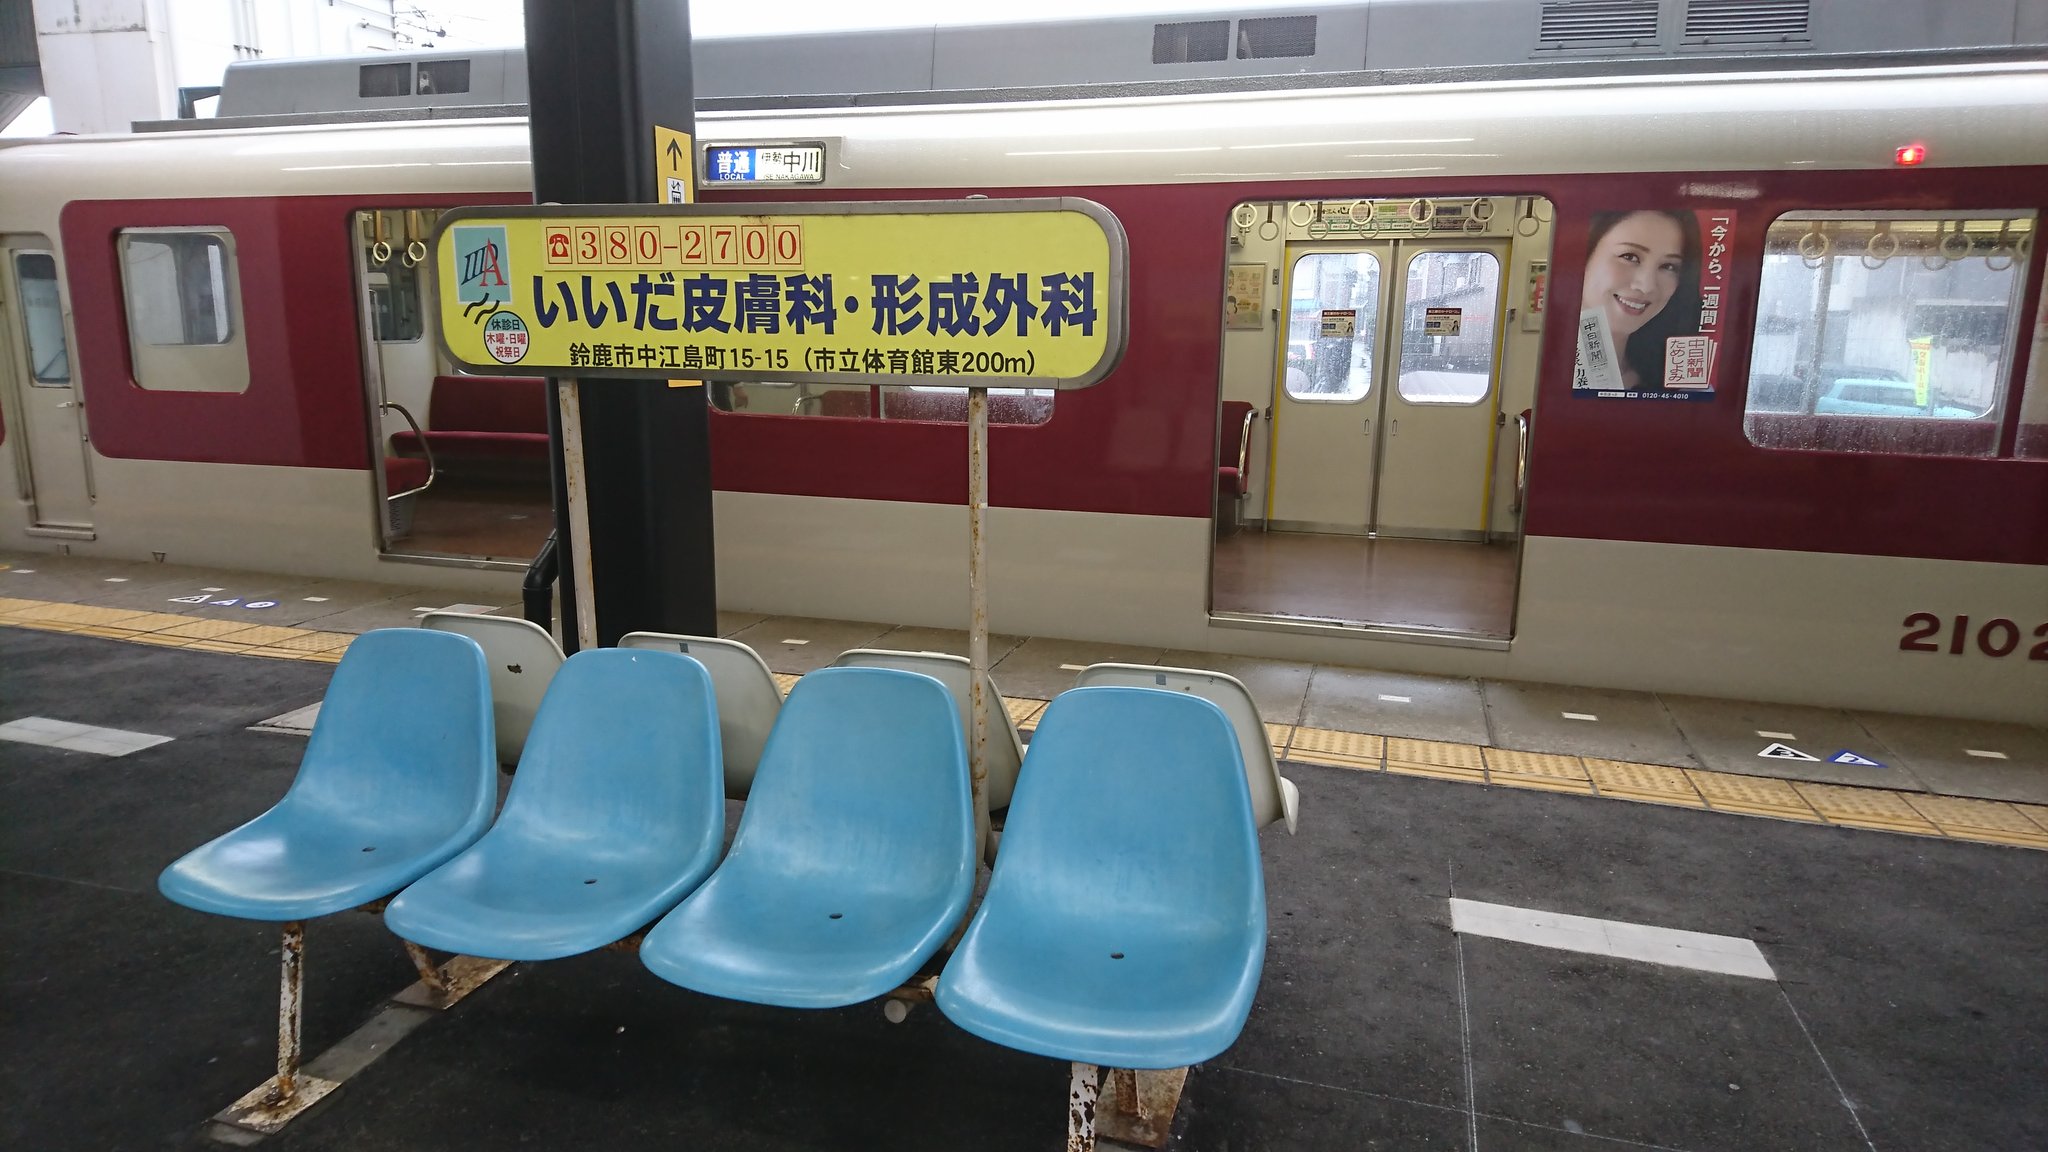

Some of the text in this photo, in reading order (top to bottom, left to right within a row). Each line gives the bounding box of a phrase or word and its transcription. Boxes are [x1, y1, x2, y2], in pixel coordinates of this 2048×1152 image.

[716, 151, 750, 174] 普通
[580, 230, 797, 260] 380-2700
[1698, 216, 1730, 333] 「今から、一週間」
[533, 271, 1098, 337] いいだ皮膚科・形成外科
[486, 332, 526, 345] 木曜・日曜
[491, 318, 520, 331] 休診日
[495, 346, 520, 358] 祝祭日
[1668, 340, 1685, 382] ためしよみ
[1686, 339, 1705, 378] 中日新聞
